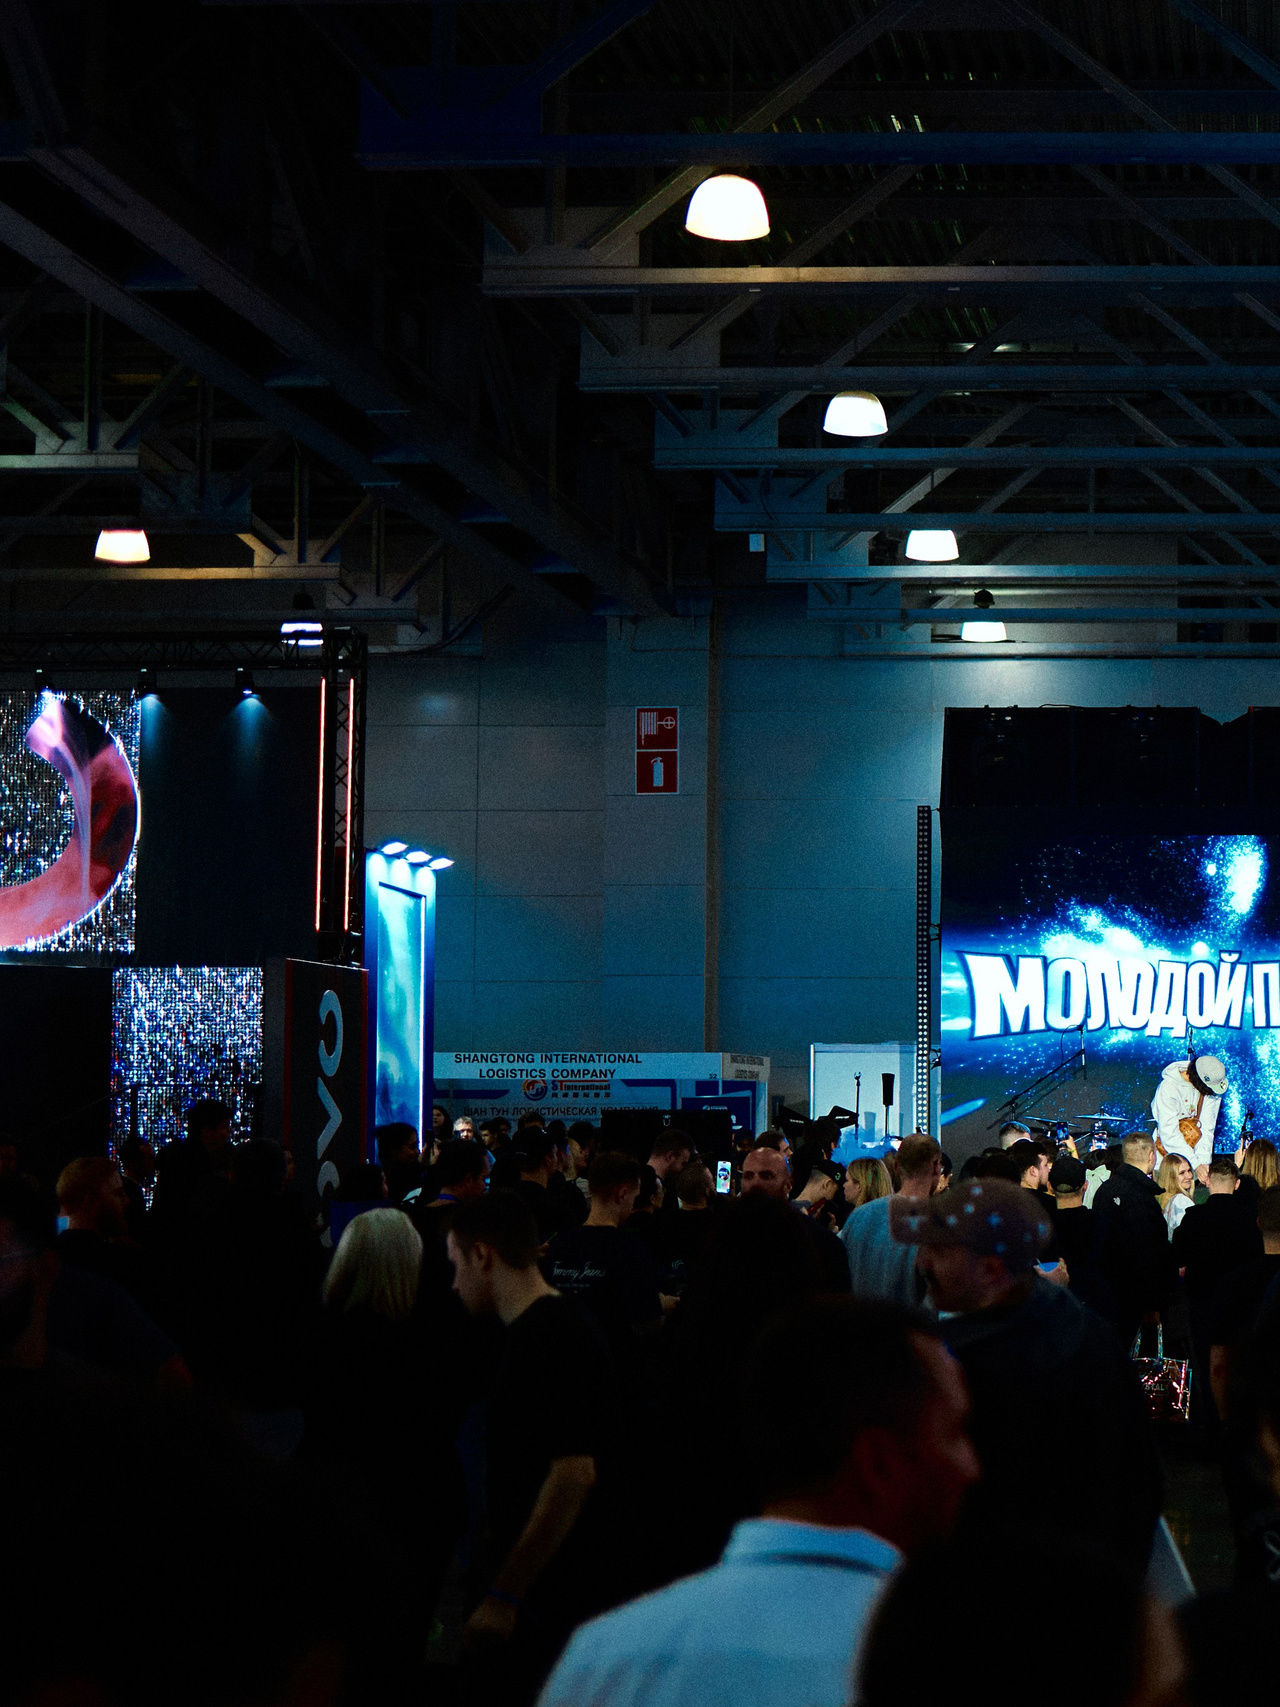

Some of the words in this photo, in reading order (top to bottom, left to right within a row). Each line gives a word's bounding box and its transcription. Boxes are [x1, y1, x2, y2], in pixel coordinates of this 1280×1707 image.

[960, 949, 1248, 1038] МОЛОДОЙ
[454, 1053, 535, 1064] SHANGTONG
[540, 1053, 642, 1064] INTERNATIONAL
[479, 1068, 546, 1079] LOGISTICS
[551, 1068, 616, 1079] COMPANY
